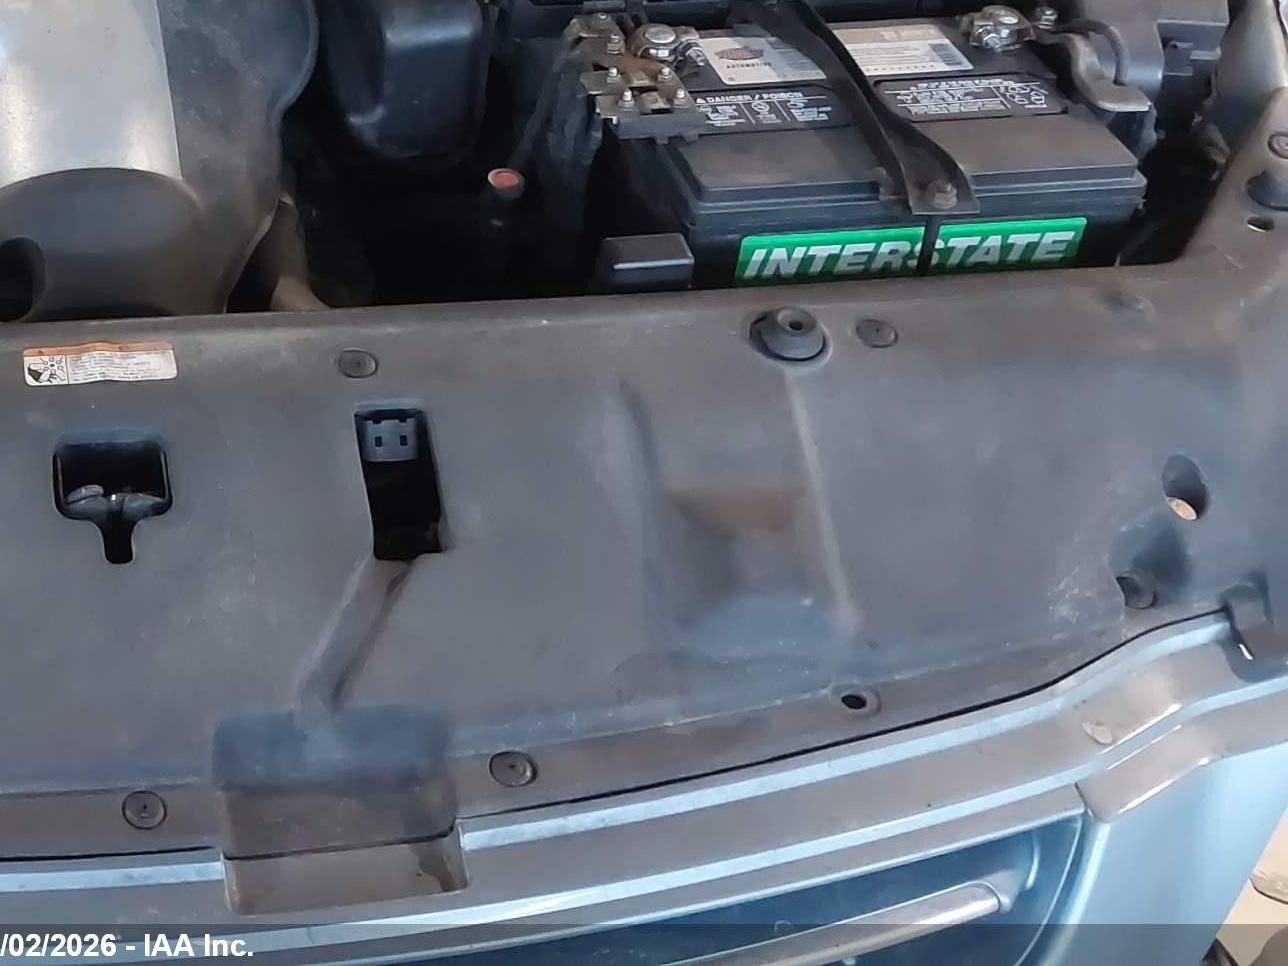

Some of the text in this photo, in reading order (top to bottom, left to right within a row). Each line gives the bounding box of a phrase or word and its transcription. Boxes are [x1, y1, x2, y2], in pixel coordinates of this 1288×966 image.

[706, 95, 752, 103] DANGER
[762, 91, 804, 100] POISON
[743, 232, 1075, 279] INTERSTATE
